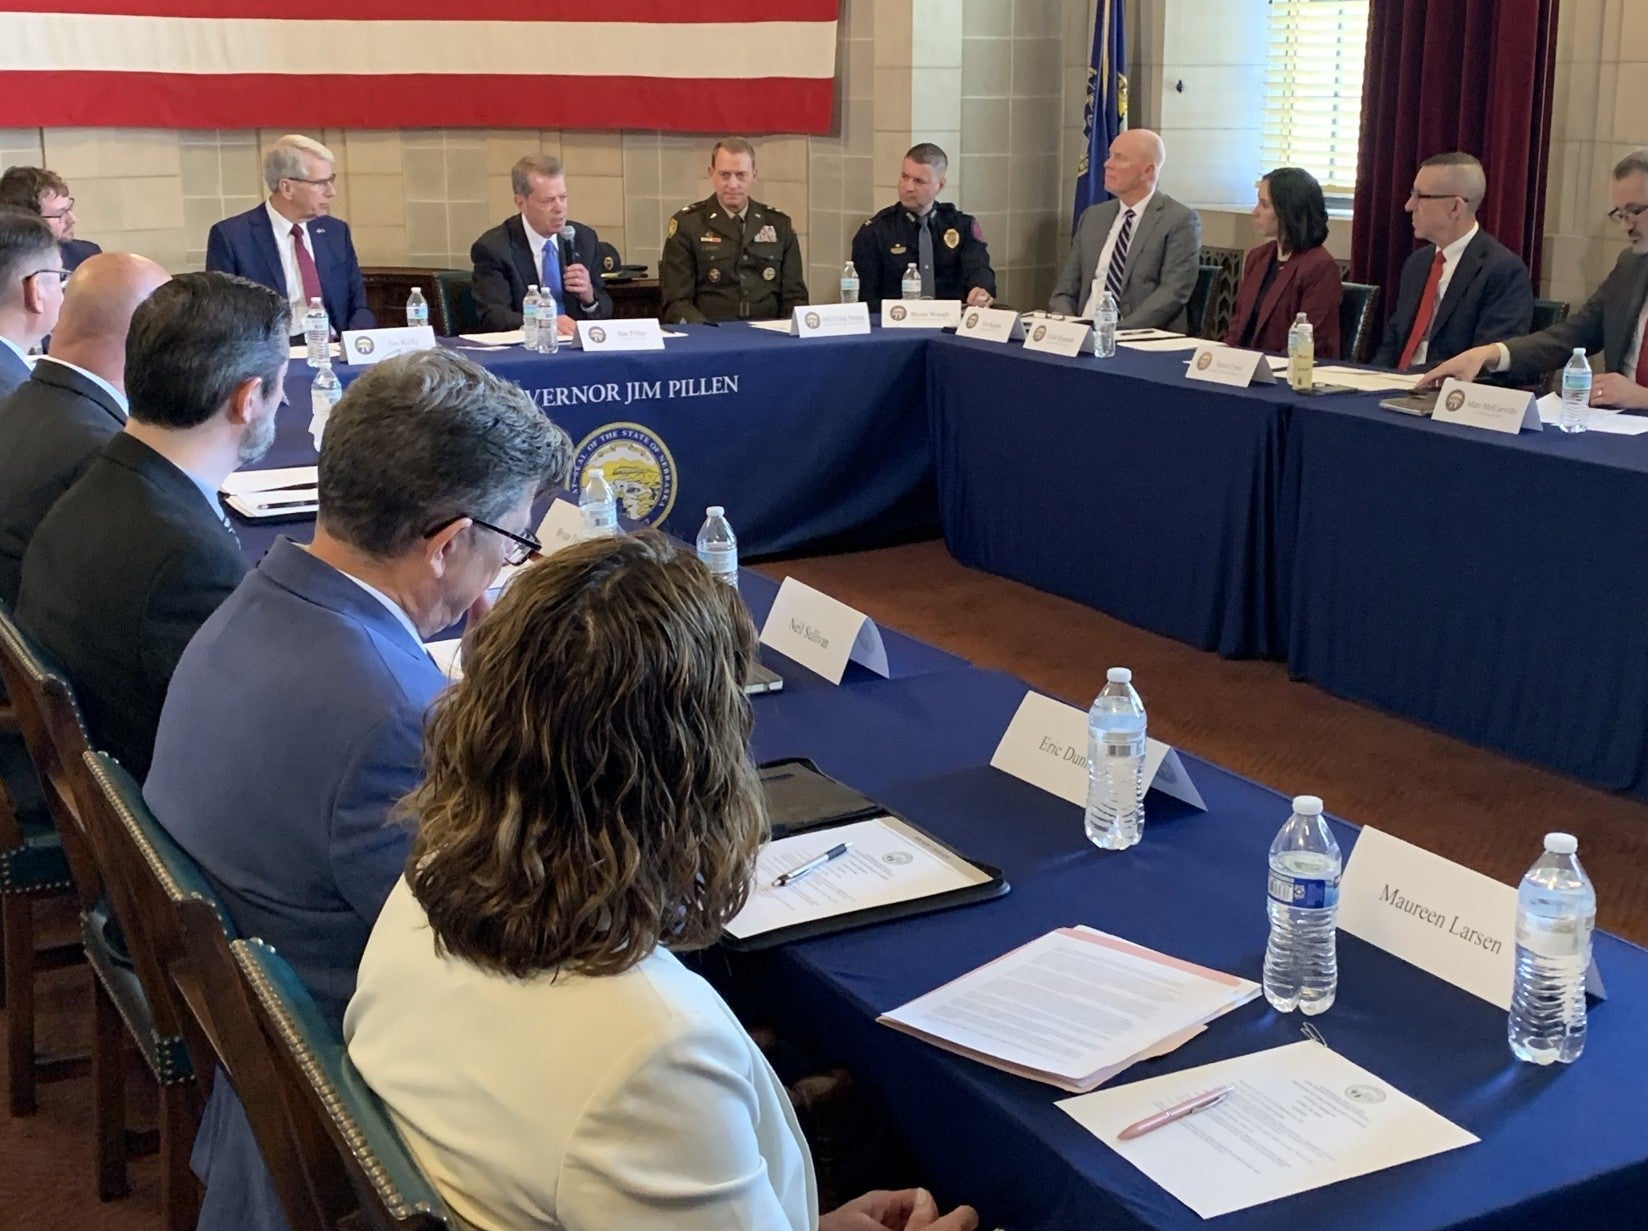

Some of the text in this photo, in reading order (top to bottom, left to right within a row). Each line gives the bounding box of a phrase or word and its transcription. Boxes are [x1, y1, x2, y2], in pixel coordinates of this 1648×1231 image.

[524, 375, 739, 407] VERNOR JIM PILLEN
[600, 430, 617, 442] THE
[621, 429, 649, 445] STATE
[658, 454, 671, 507] NEBRASKA
[789, 617, 829, 650] Neil Sullivan
[1038, 736, 1063, 757] Eric
[1378, 884, 1503, 955] Maureen Larsen
